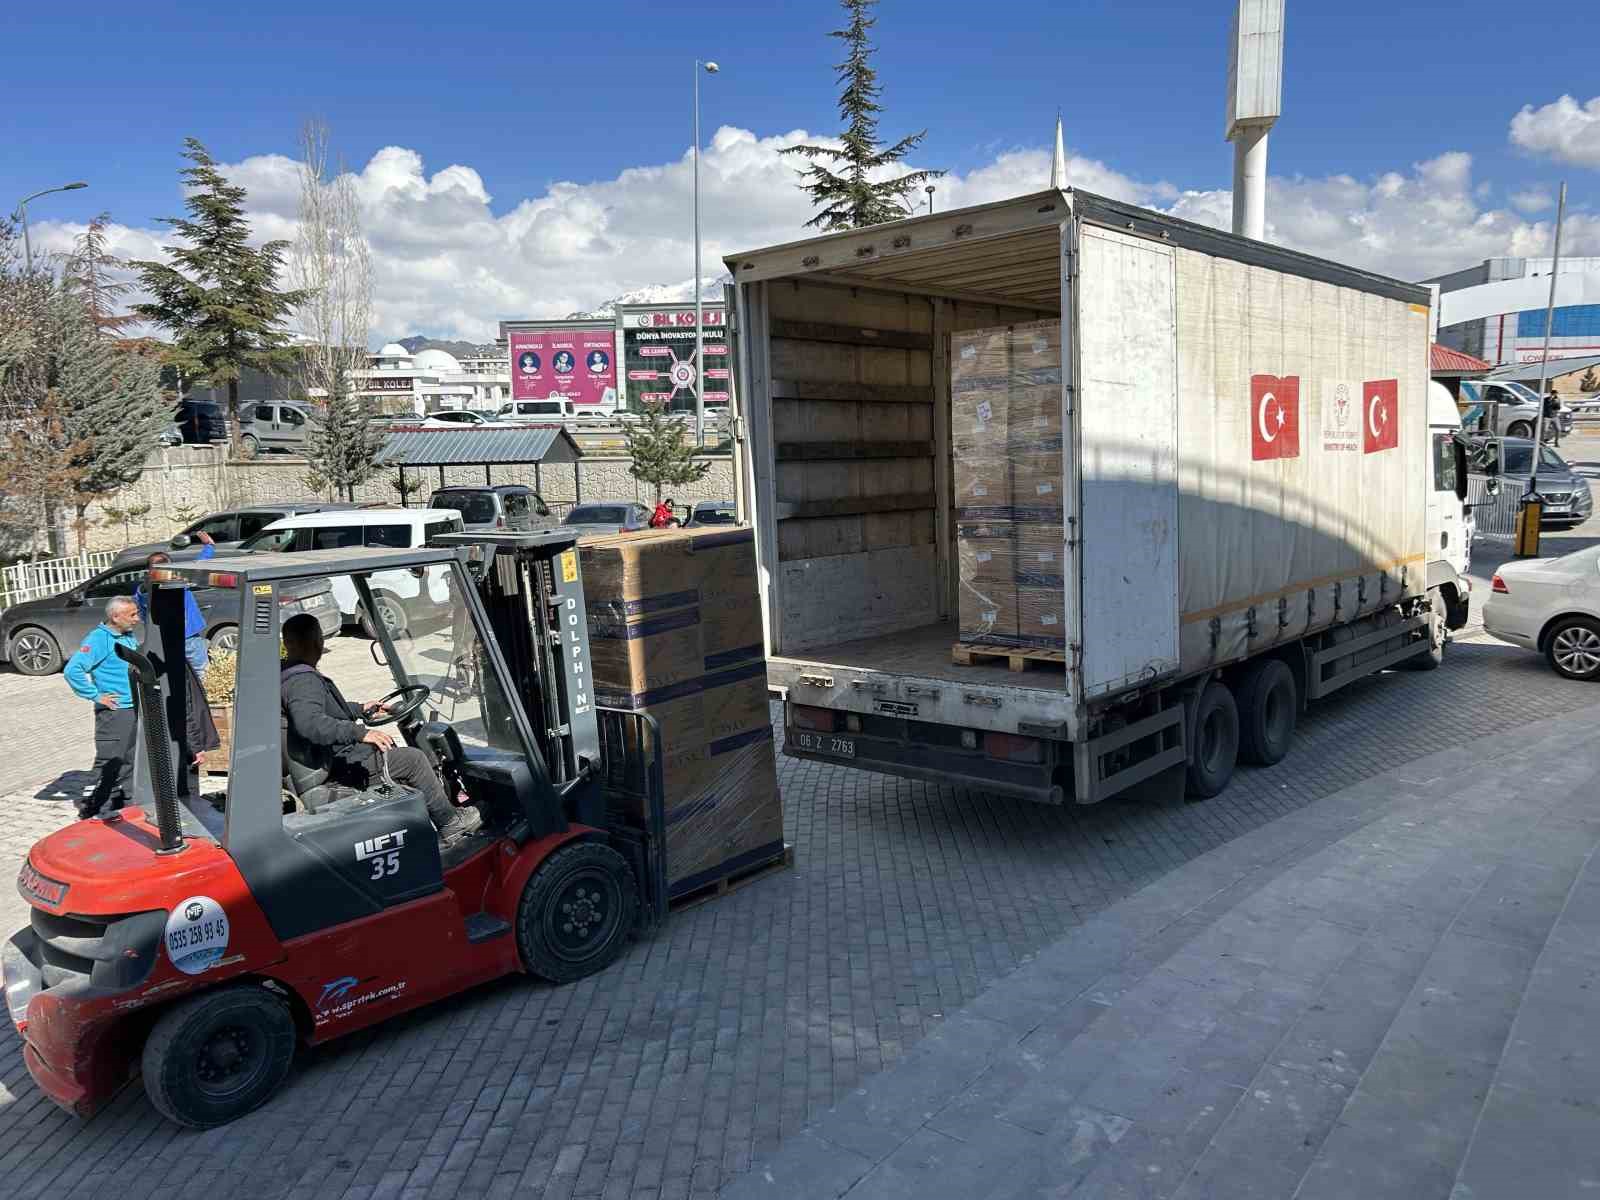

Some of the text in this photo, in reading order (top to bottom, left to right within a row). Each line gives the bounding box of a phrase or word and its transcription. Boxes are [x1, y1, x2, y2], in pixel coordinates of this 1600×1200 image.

[636, 331, 659, 340] DÜNYA
[566, 598, 587, 705] DOLPHIN
[800, 734, 811, 747] 06
[354, 829, 408, 862] LIFT
[370, 851, 400, 880] 35
[168, 919, 225, 951] 0535 258 93 45
